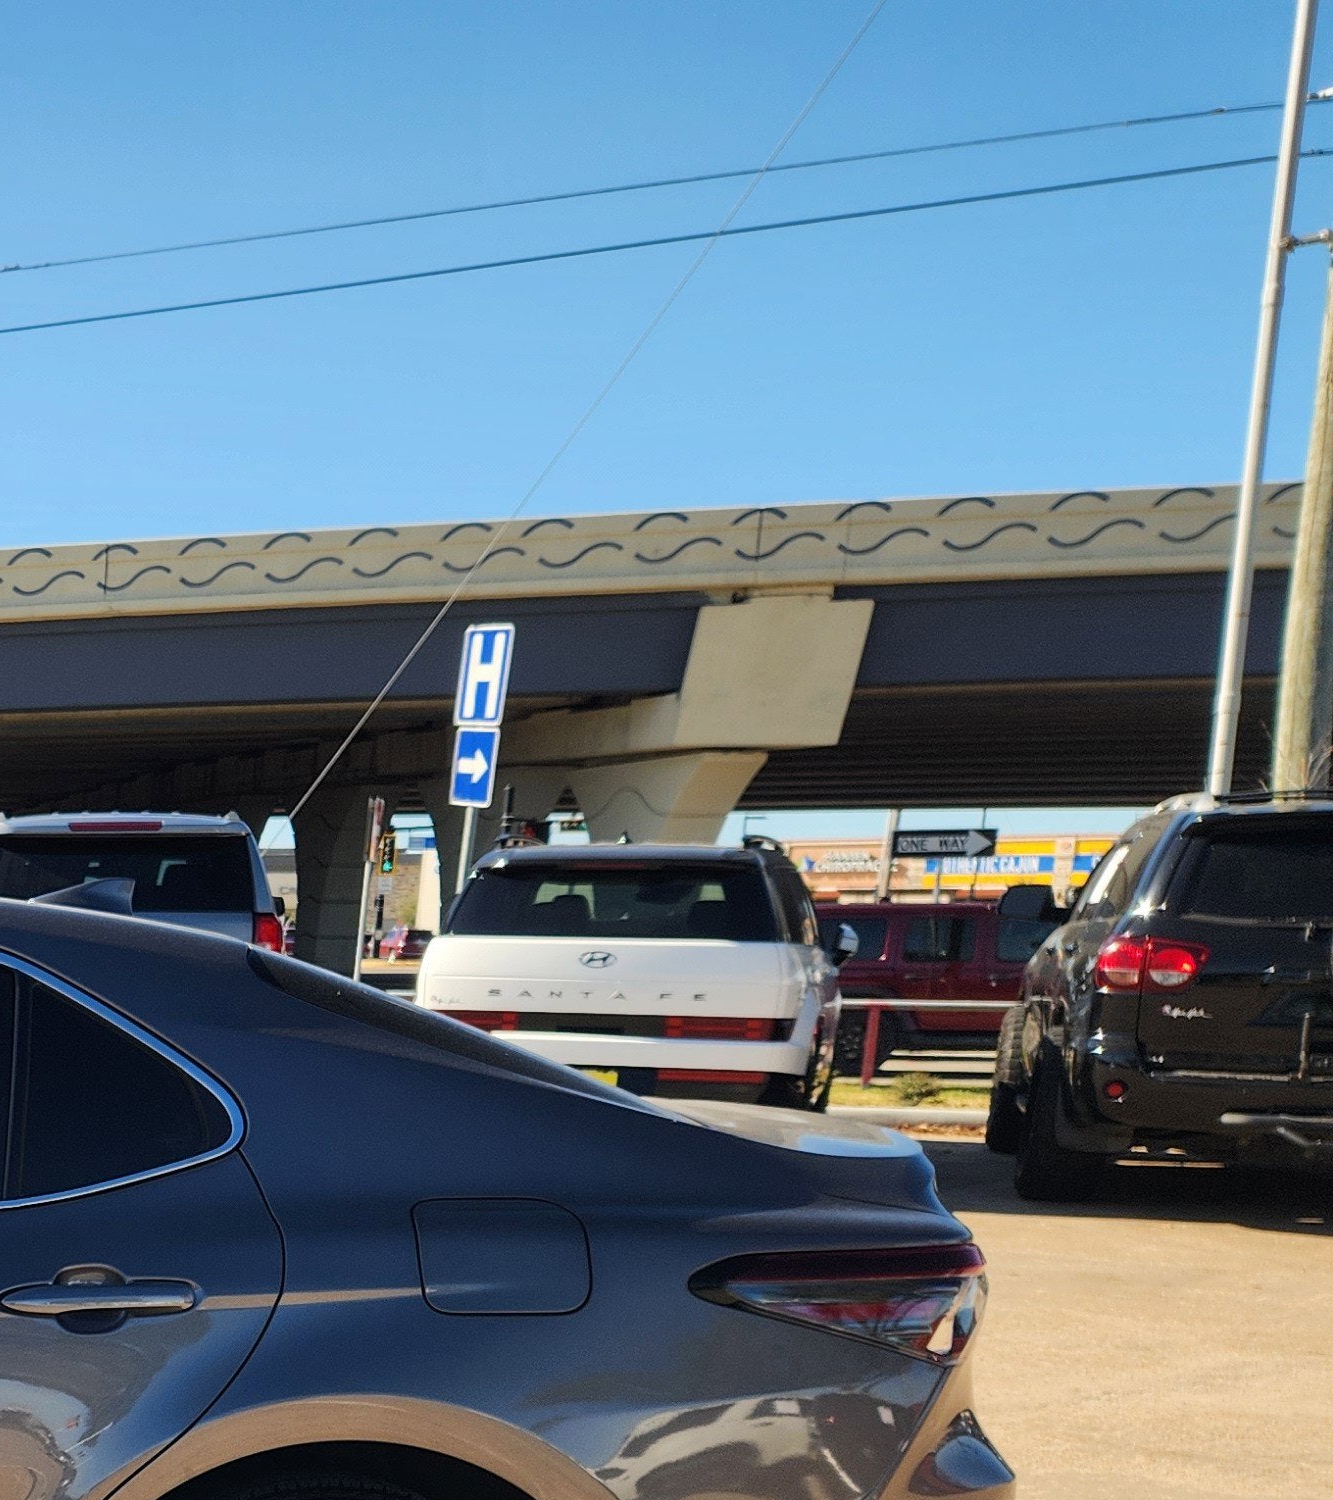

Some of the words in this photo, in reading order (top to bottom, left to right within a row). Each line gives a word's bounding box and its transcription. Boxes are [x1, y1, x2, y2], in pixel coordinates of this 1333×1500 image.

[462, 632, 507, 719] H
[899, 837, 928, 852] ONE
[939, 836, 968, 851] WAY
[488, 988, 626, 1000] SANTA
[659, 993, 707, 1001] FE
